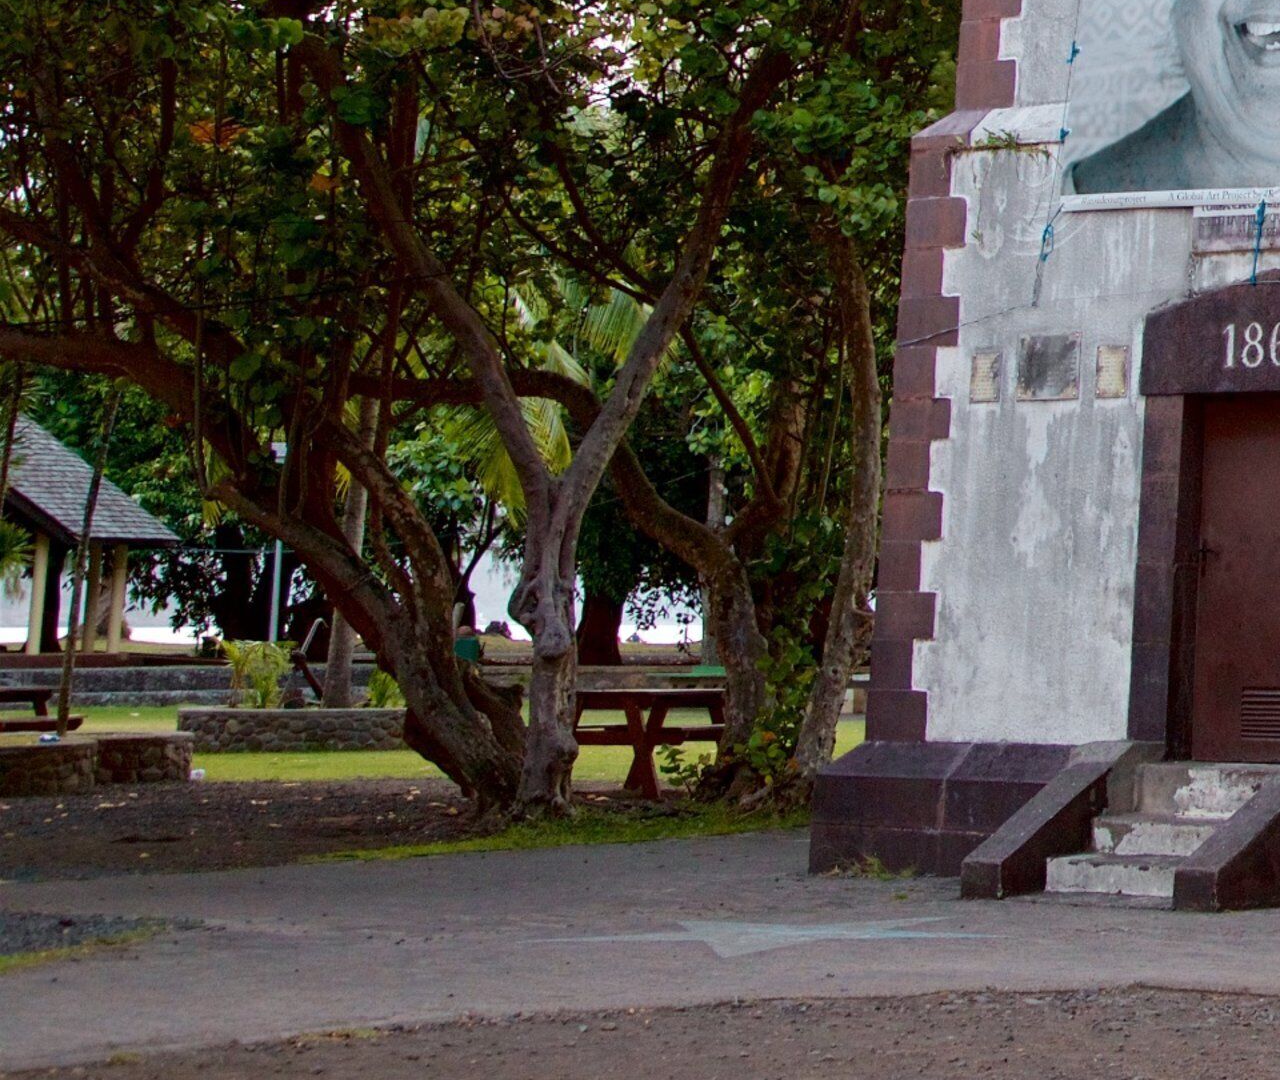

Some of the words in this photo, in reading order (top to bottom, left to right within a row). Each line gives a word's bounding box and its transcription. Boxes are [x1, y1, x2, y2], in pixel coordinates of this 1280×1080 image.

[1168, 192, 1175, 201] A
[1176, 191, 1204, 201] Global
[1206, 191, 1219, 200] Art
[1221, 189, 1251, 202] Project
